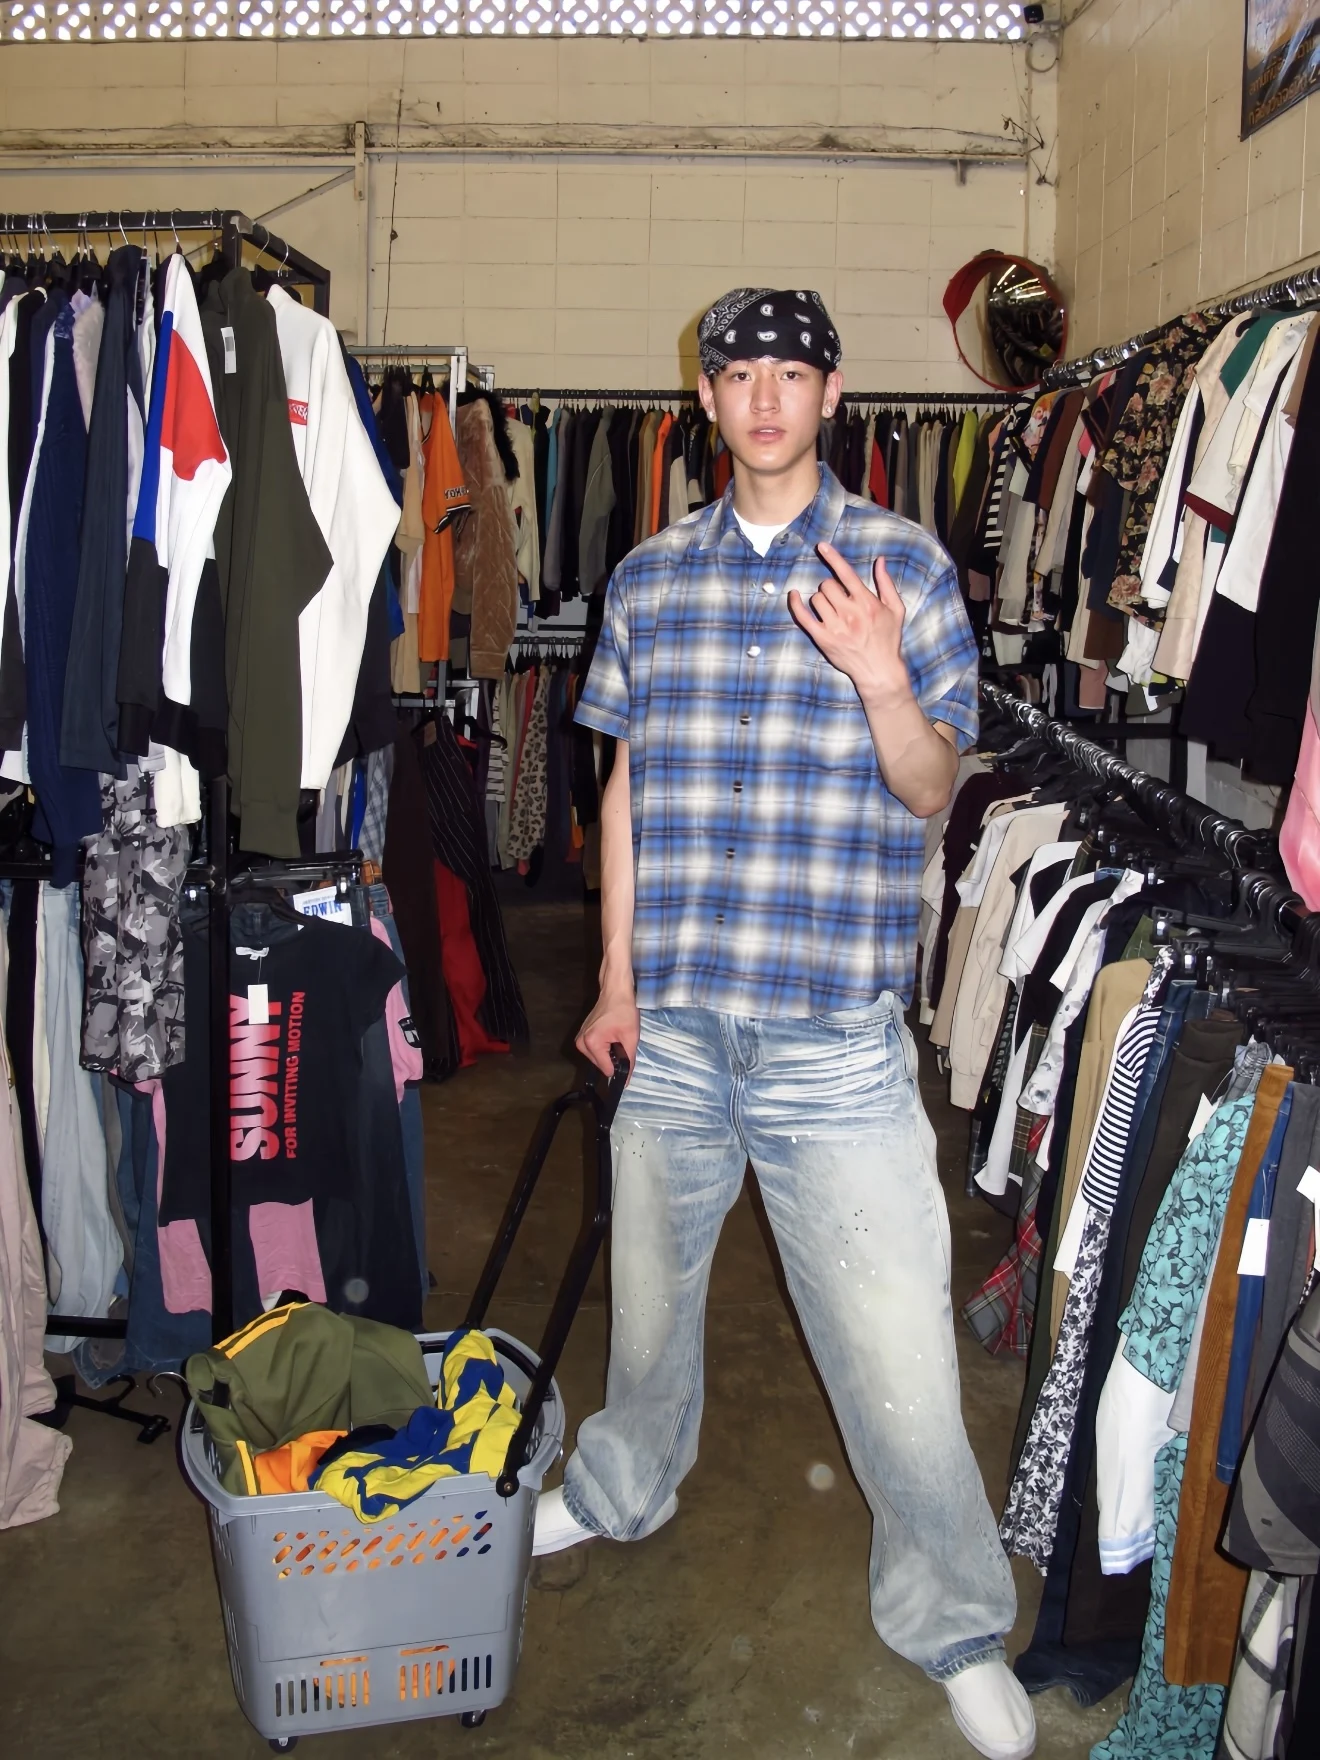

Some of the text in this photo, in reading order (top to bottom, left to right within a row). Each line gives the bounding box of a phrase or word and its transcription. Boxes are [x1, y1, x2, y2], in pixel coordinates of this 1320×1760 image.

[284, 991, 306, 1159] FOR INVITING MOTION
